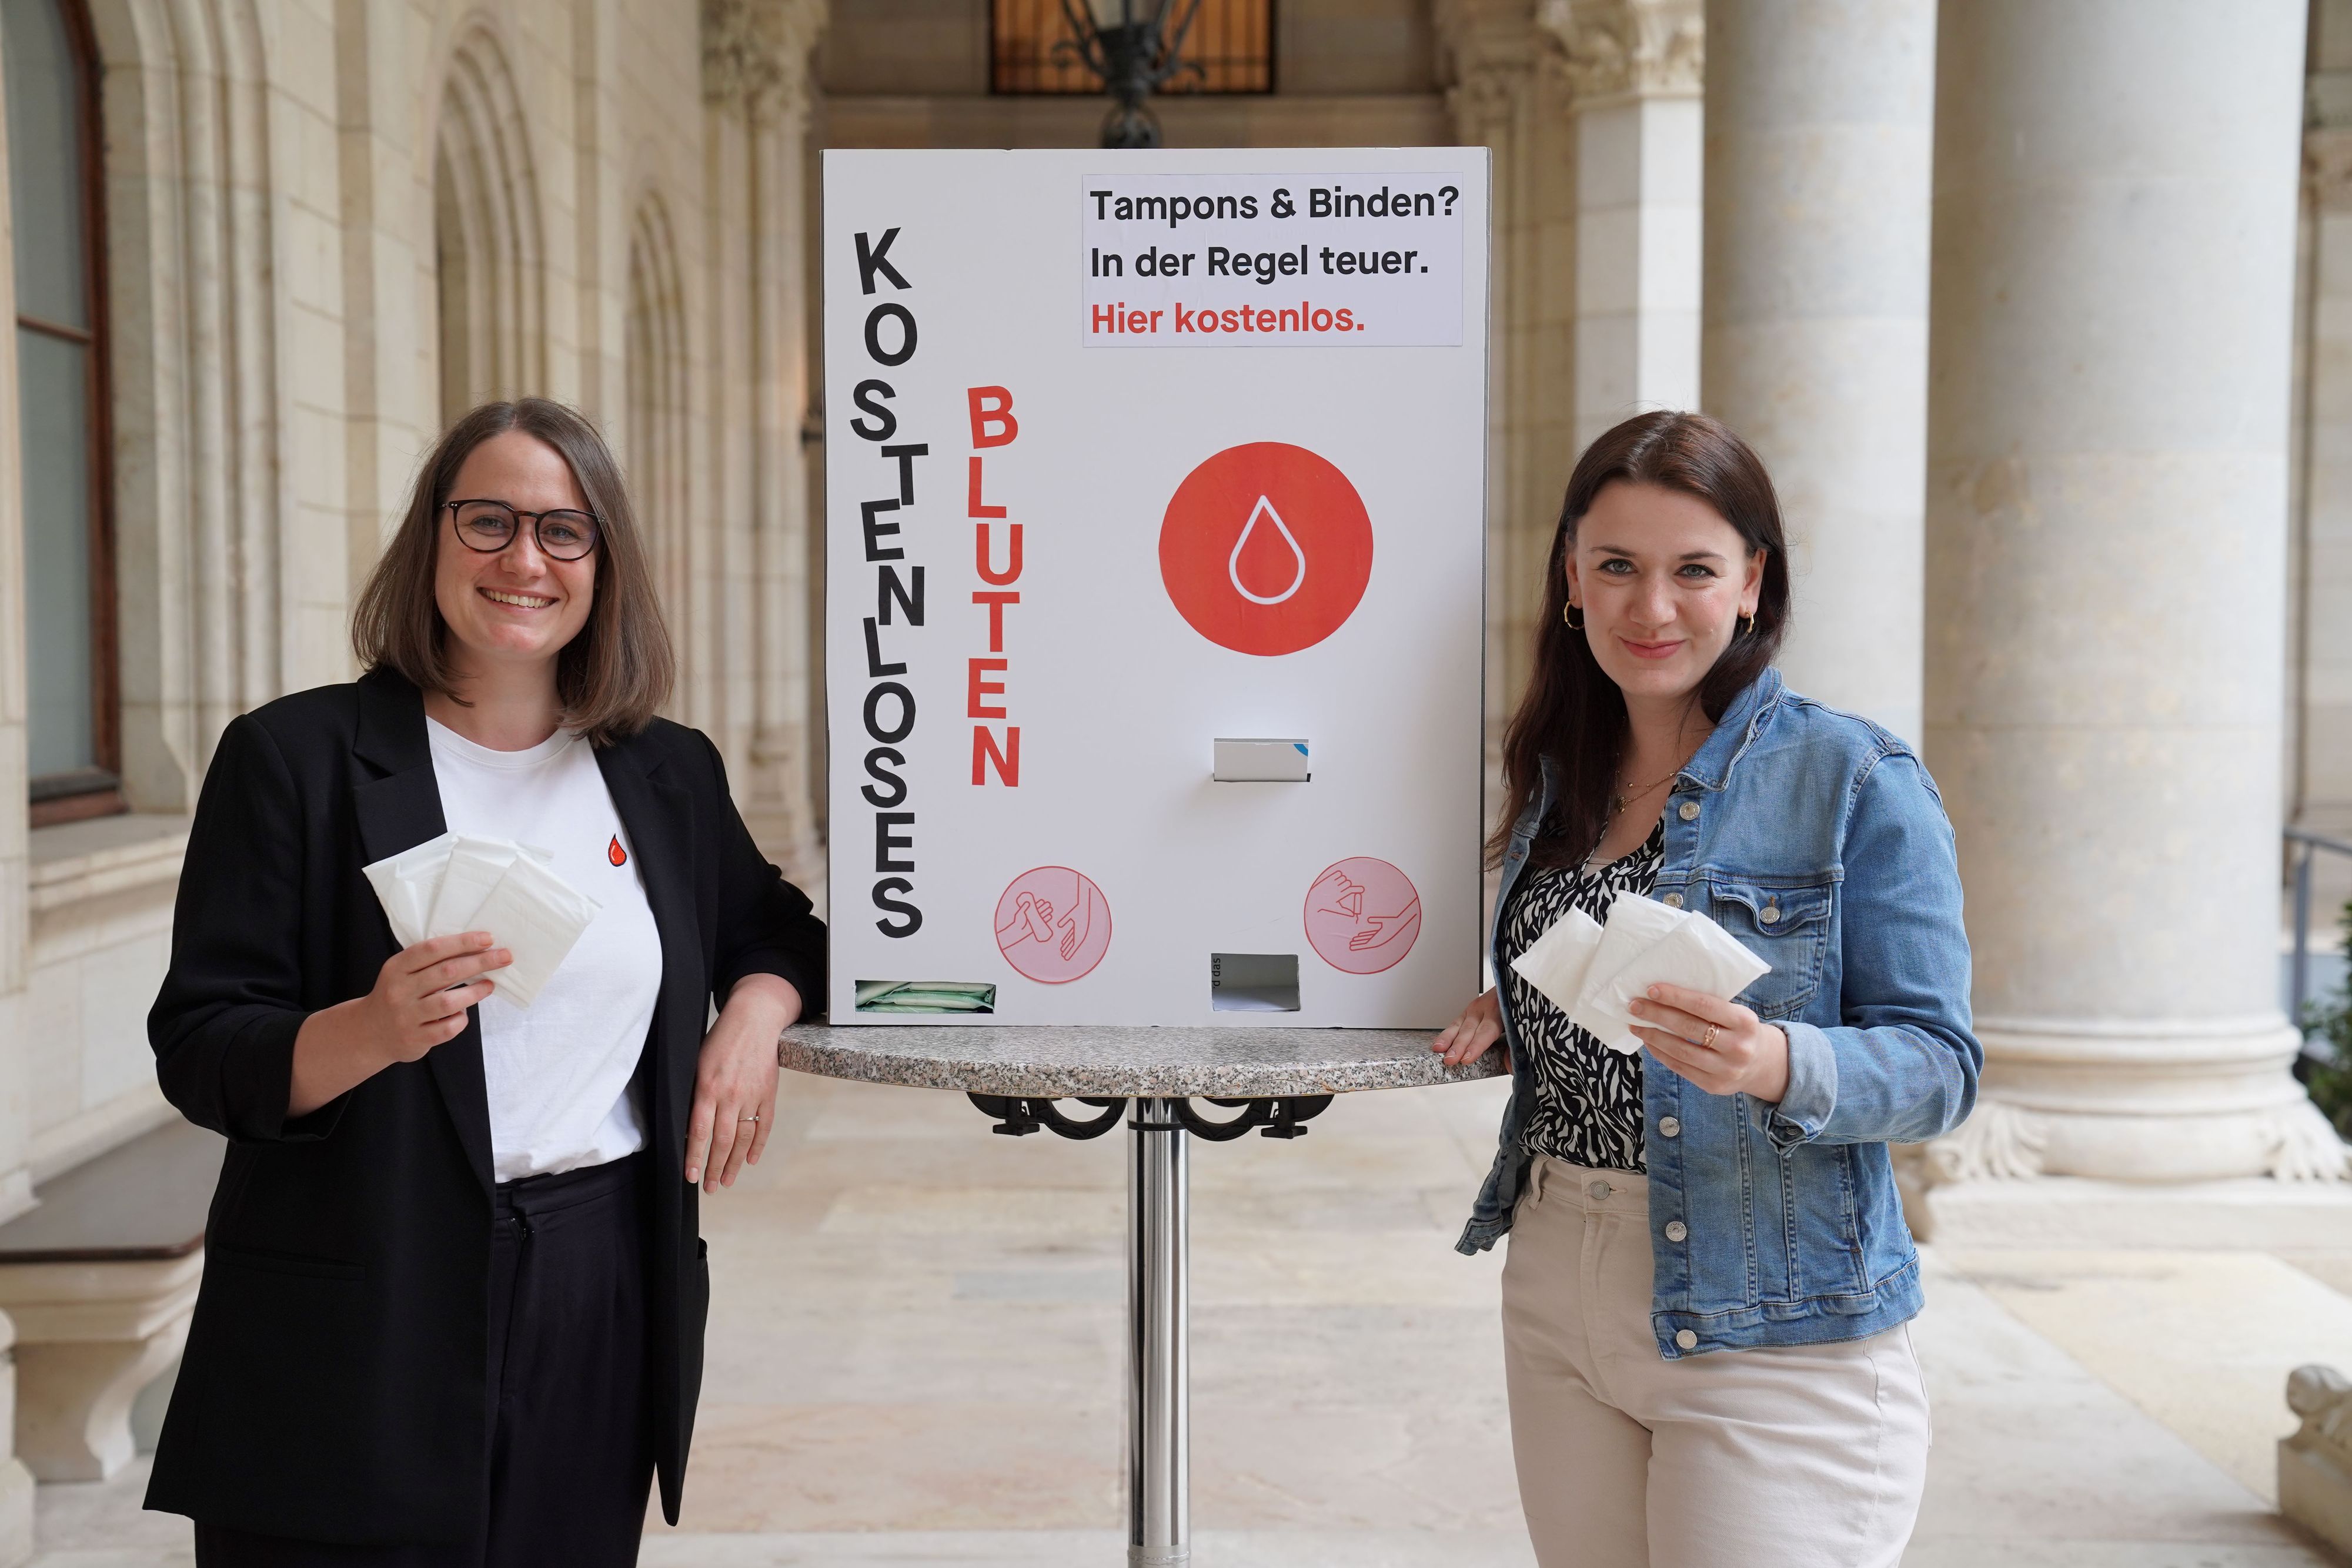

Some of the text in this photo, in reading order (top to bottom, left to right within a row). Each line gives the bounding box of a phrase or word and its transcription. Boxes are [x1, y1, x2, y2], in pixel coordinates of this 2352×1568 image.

[1090, 186, 1459, 228] Tampons & Binden?
[1092, 245, 1428, 285] In der Regel teuer.
[1093, 301, 1364, 333] Hier kostenlos.
[850, 228, 928, 938] KOSTENLOSES
[968, 386, 1023, 787] BLUTEN
[1212, 958, 1221, 977] das
